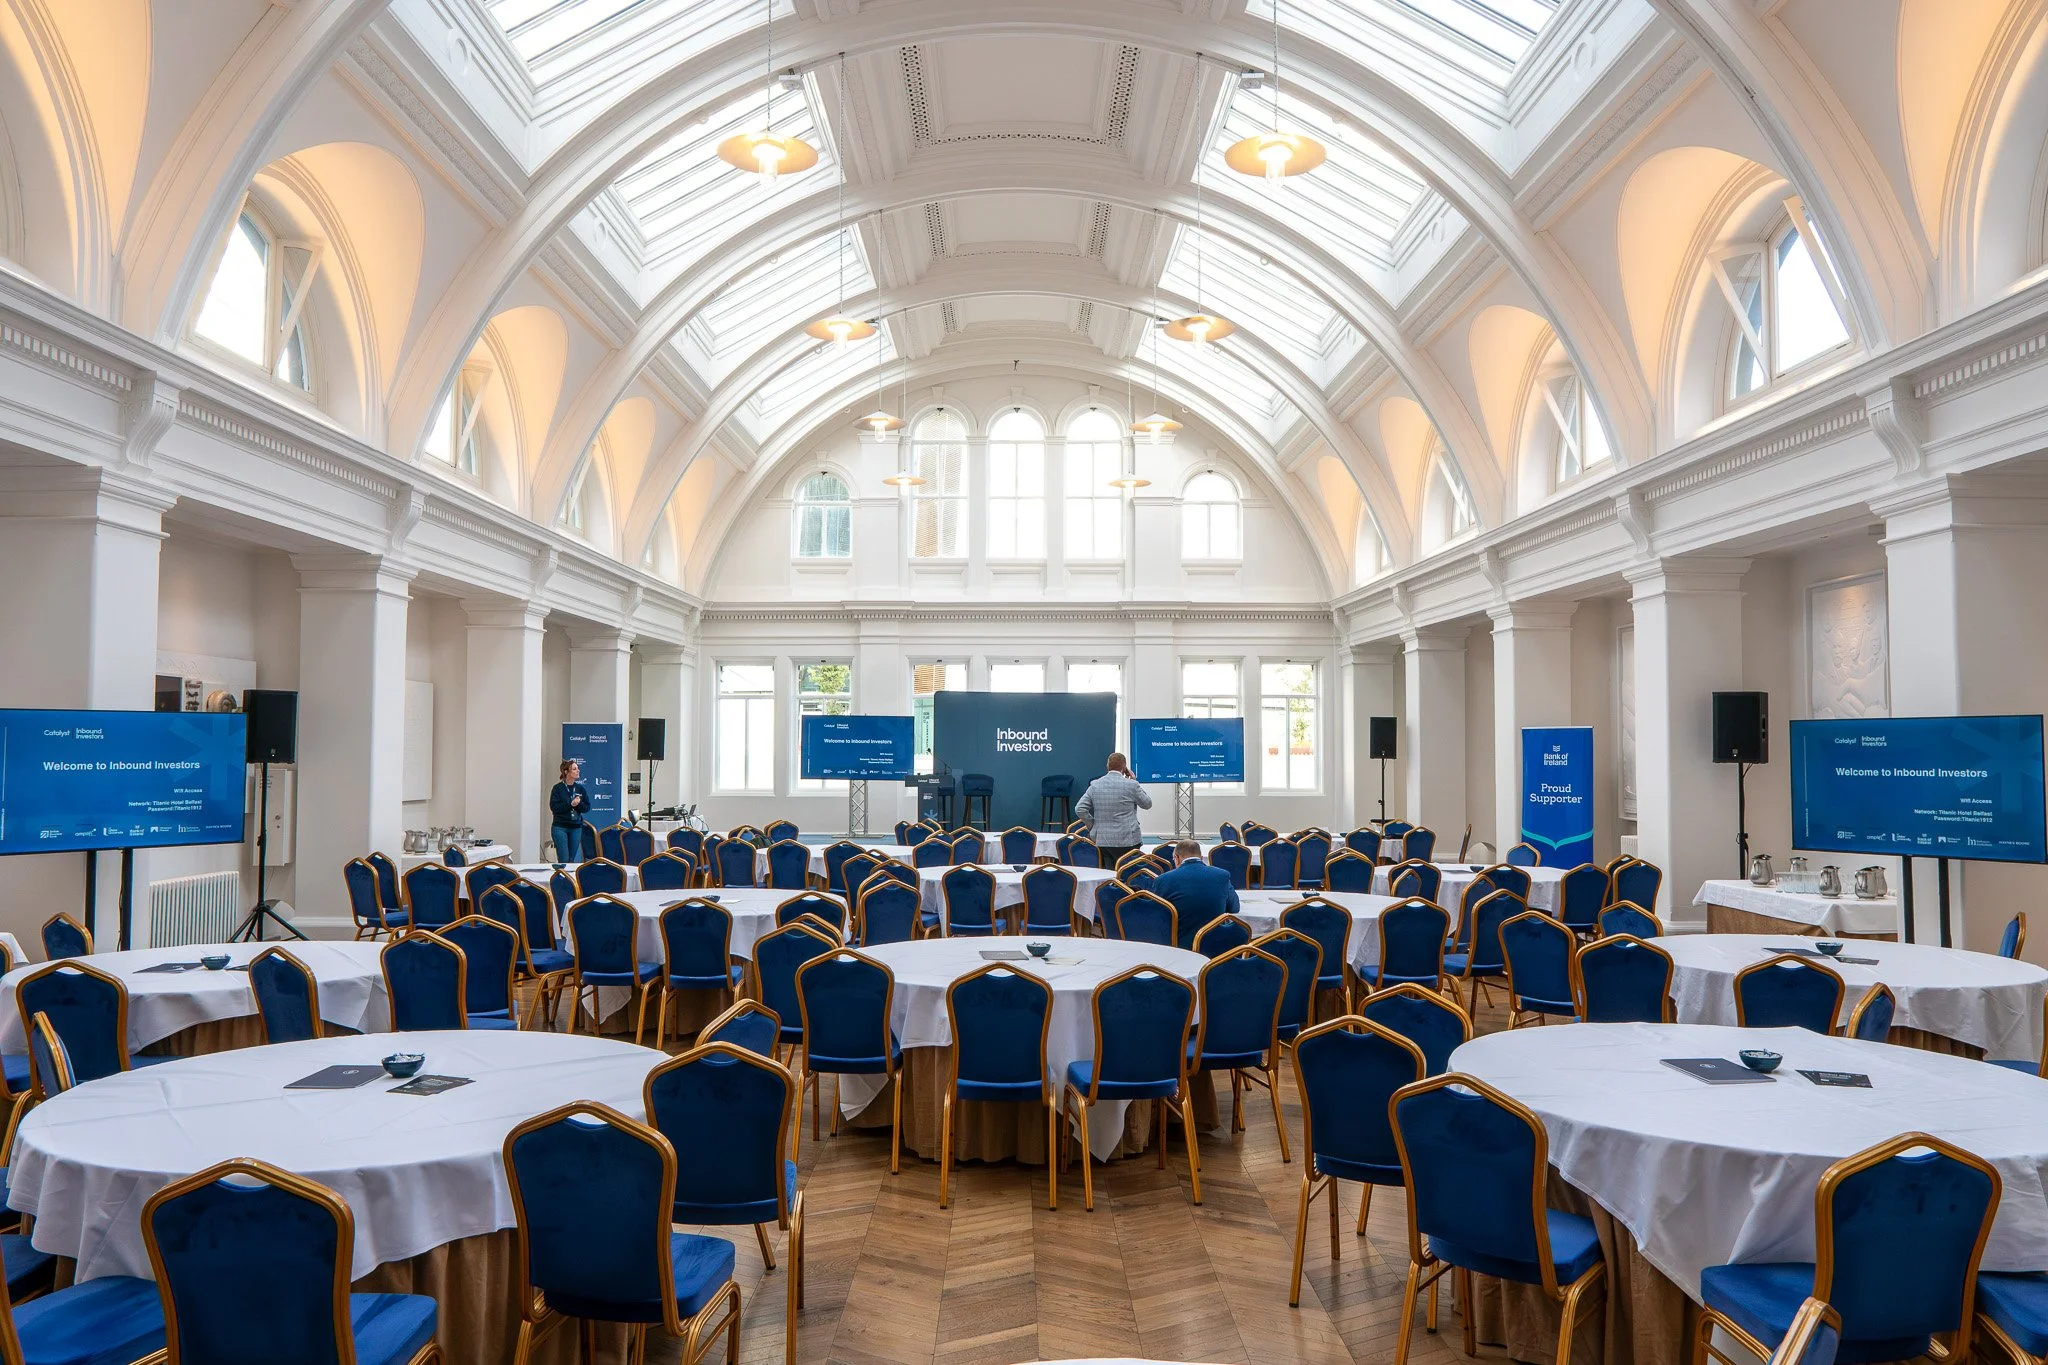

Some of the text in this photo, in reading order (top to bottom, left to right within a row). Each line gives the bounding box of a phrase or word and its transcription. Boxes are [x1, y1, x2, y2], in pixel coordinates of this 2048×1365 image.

[44, 729, 70, 737] Catalyst
[997, 728, 1048, 740] Inbound
[997, 740, 1052, 752] Investors
[43, 761, 200, 770] Welcome to Inbound Investors
[1835, 767, 1988, 778] Welcome to Inbound Investors
[1541, 783, 1572, 792] Proud
[1530, 793, 1582, 805] Supporter
